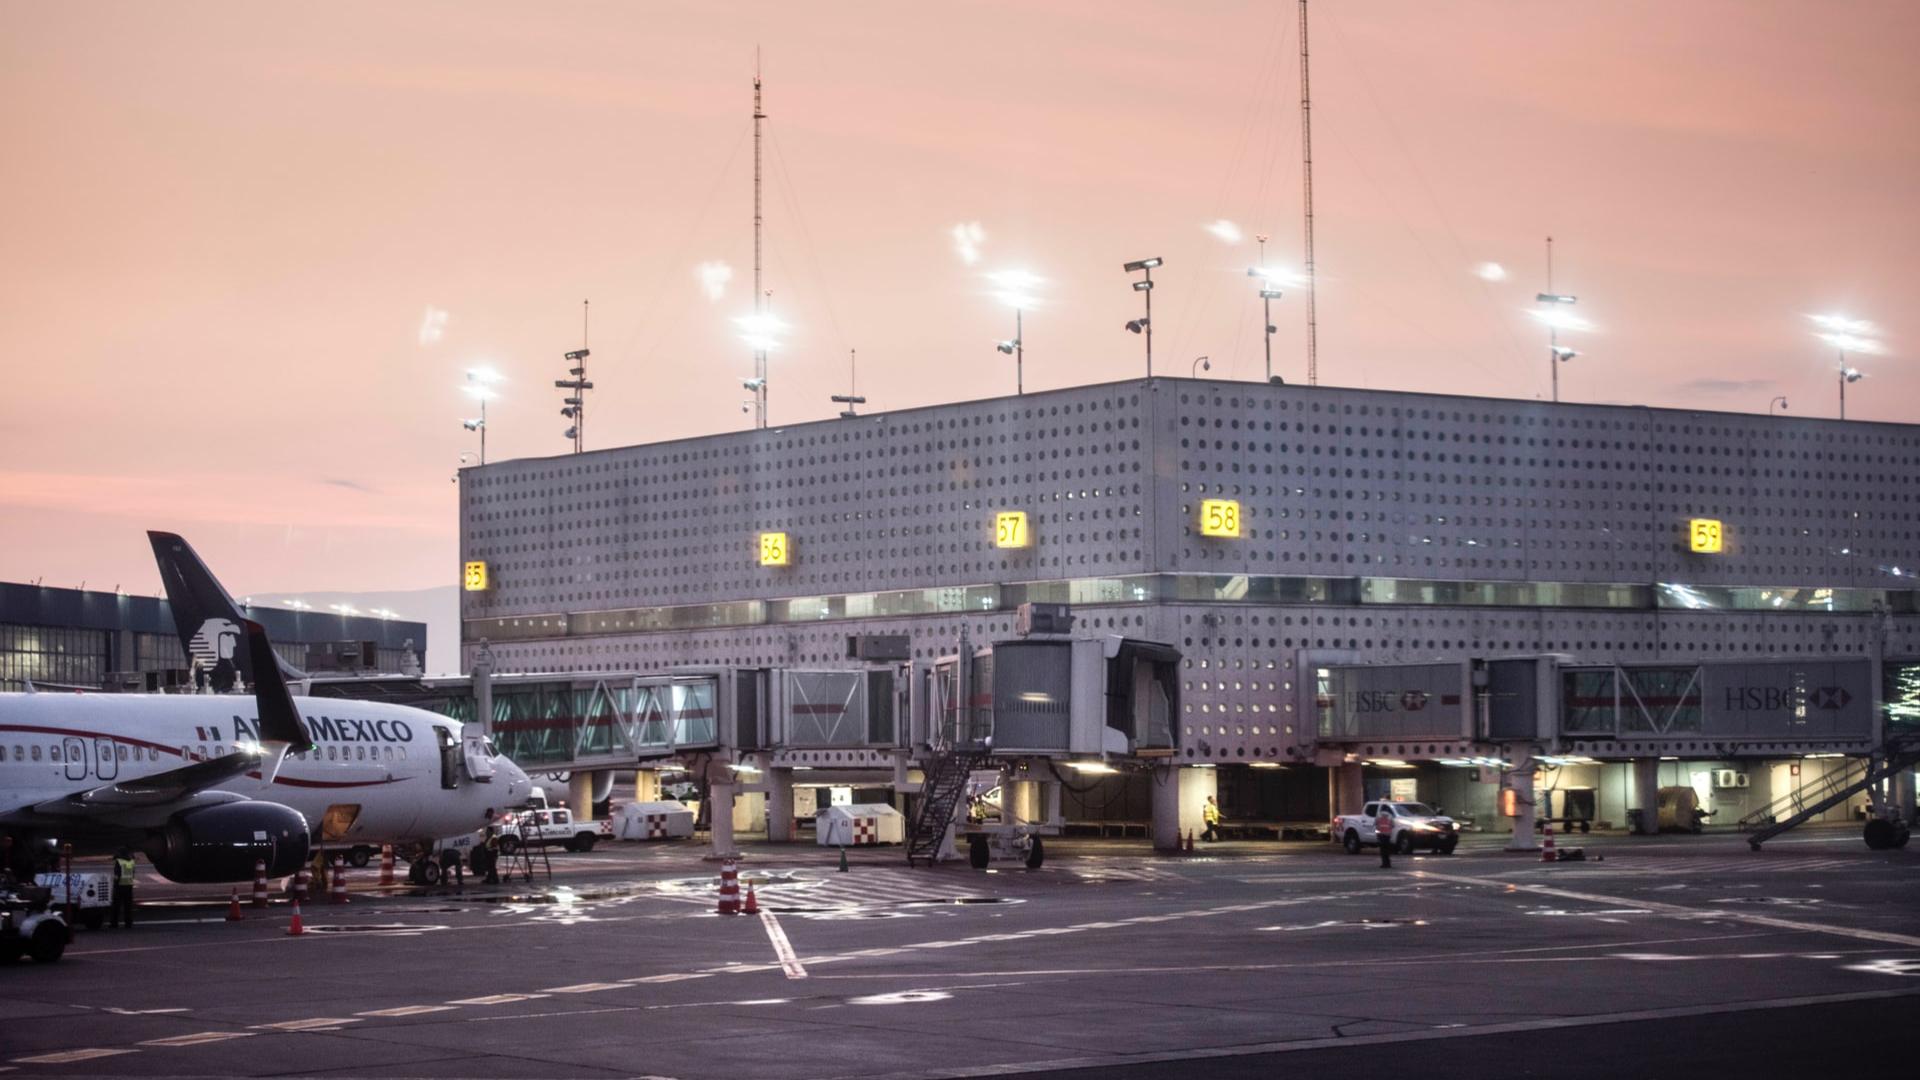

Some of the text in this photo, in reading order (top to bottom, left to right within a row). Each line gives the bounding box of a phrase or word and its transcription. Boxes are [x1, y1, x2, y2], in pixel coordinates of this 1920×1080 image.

[1000, 517, 1020, 542] 57
[1210, 506, 1235, 531] 58
[1696, 524, 1717, 547] 59
[764, 538, 782, 560] 56
[466, 565, 482, 585] 55
[1347, 690, 1395, 712] HSBC
[1725, 687, 1798, 712] HSBC
